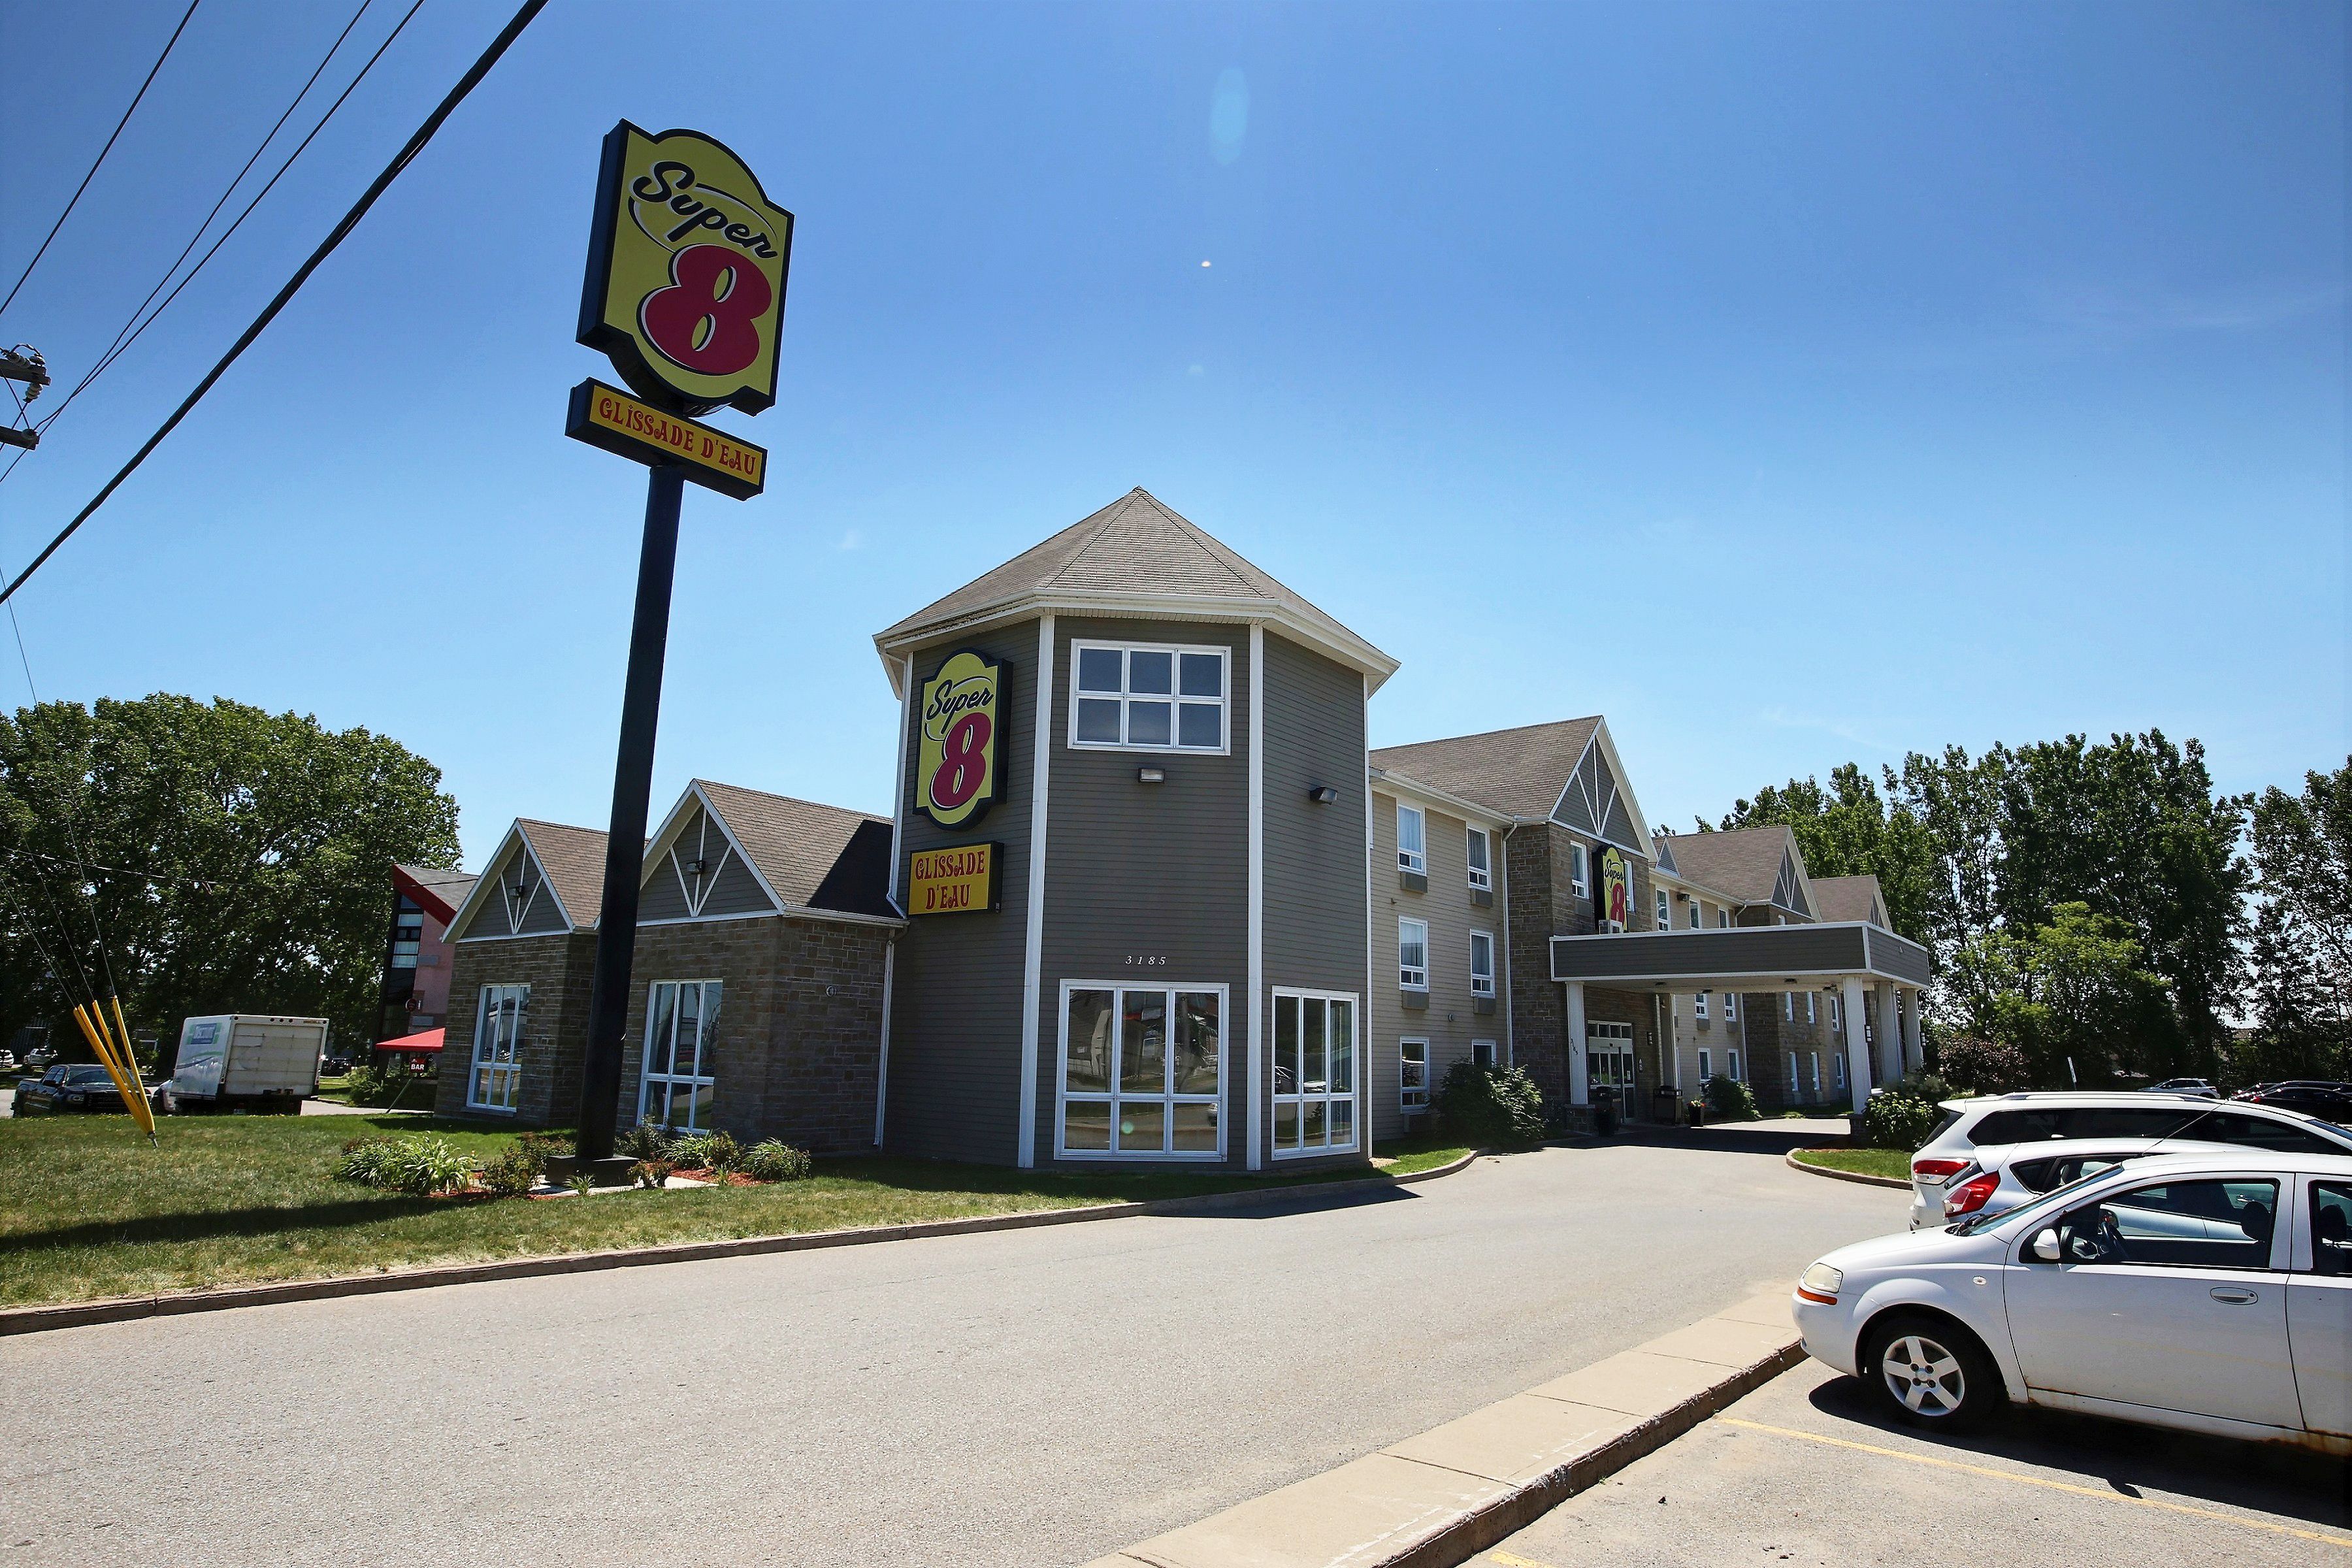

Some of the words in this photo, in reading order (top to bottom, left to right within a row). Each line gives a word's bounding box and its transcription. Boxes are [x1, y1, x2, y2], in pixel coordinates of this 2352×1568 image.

[631, 159, 779, 259] Super
[636, 243, 773, 376] 8
[700, 438, 757, 476] D'EAU
[926, 679, 994, 735] Super
[930, 711, 992, 811] 8
[1605, 858, 1624, 889] Super
[926, 883, 971, 911] D'EAU
[1610, 883, 1625, 925] 8
[1125, 955, 1166, 966] 3185
